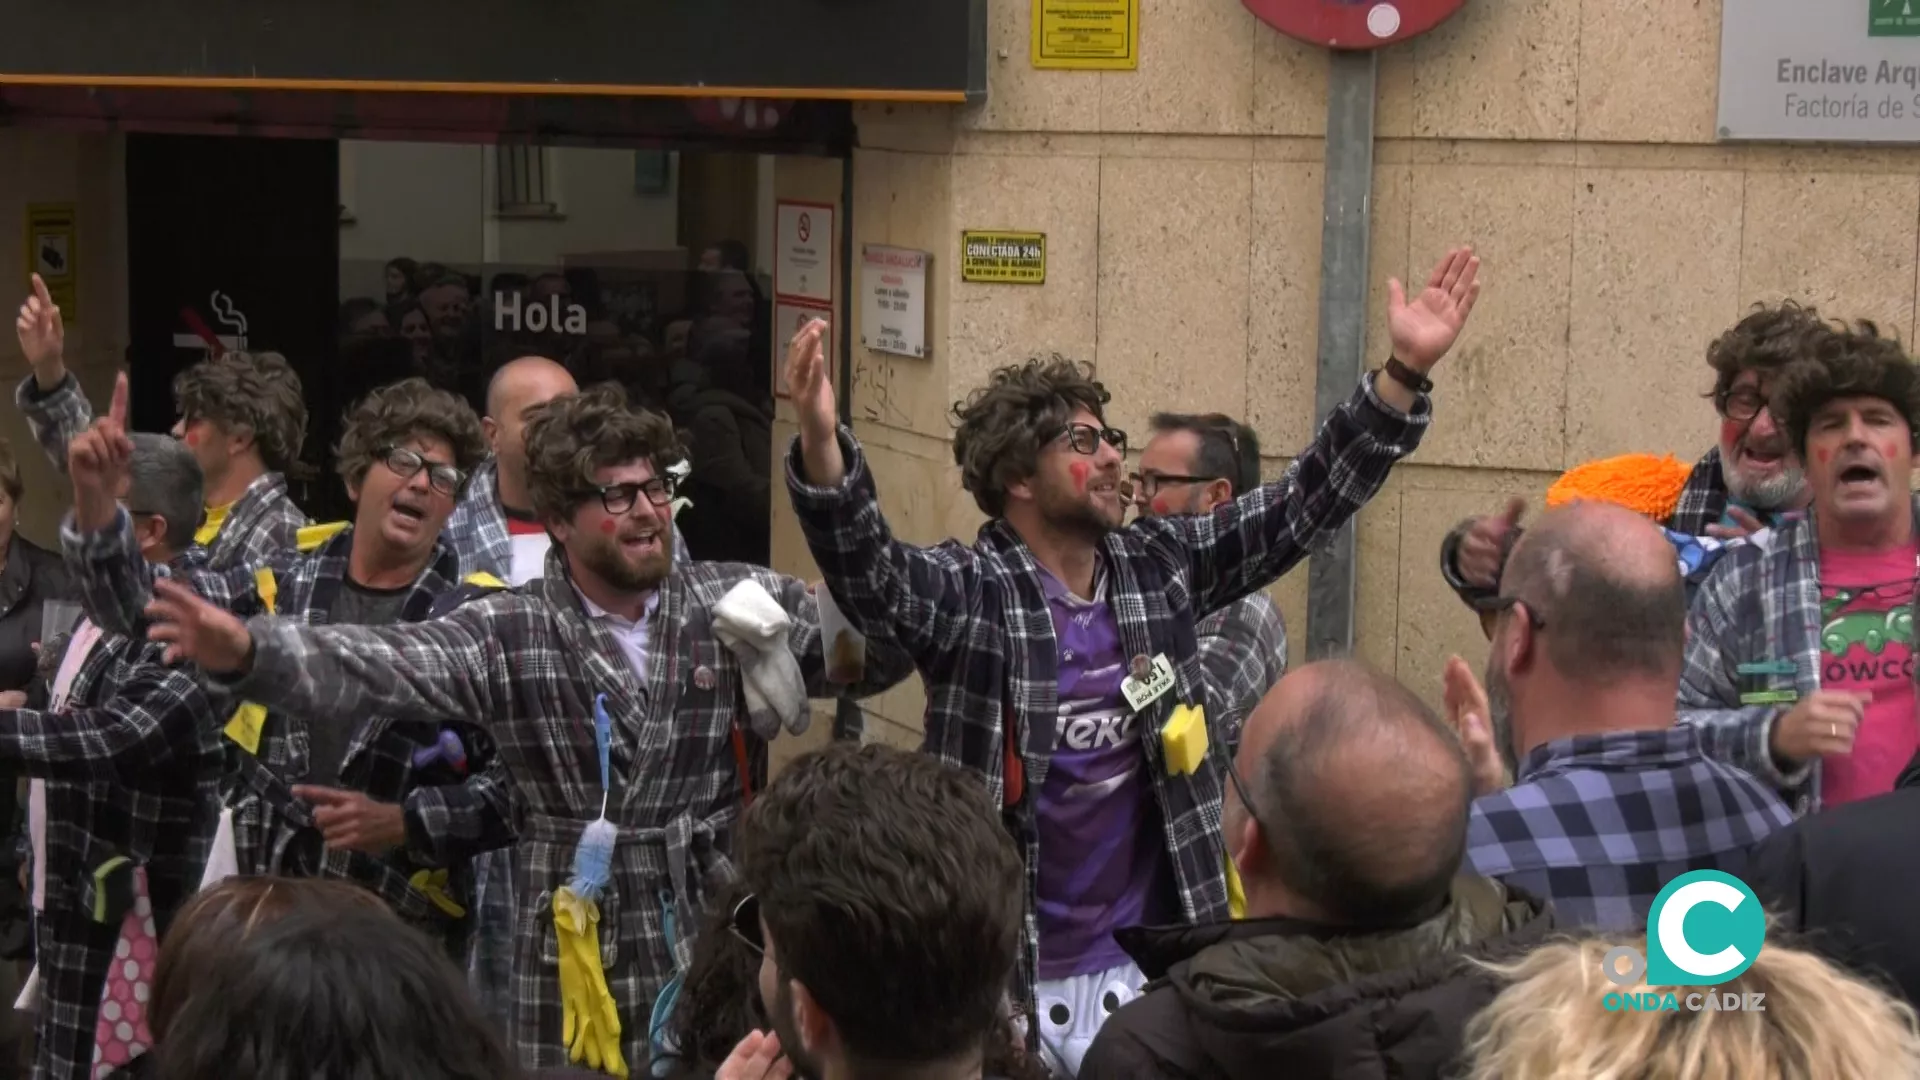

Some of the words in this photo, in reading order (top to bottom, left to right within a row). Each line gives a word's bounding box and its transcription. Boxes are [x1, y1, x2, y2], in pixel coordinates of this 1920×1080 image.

[1777, 58, 1867, 83] Enclave
[1785, 92, 1868, 118] Factoría
[1878, 94, 1904, 118] de
[495, 291, 587, 334] Hola
